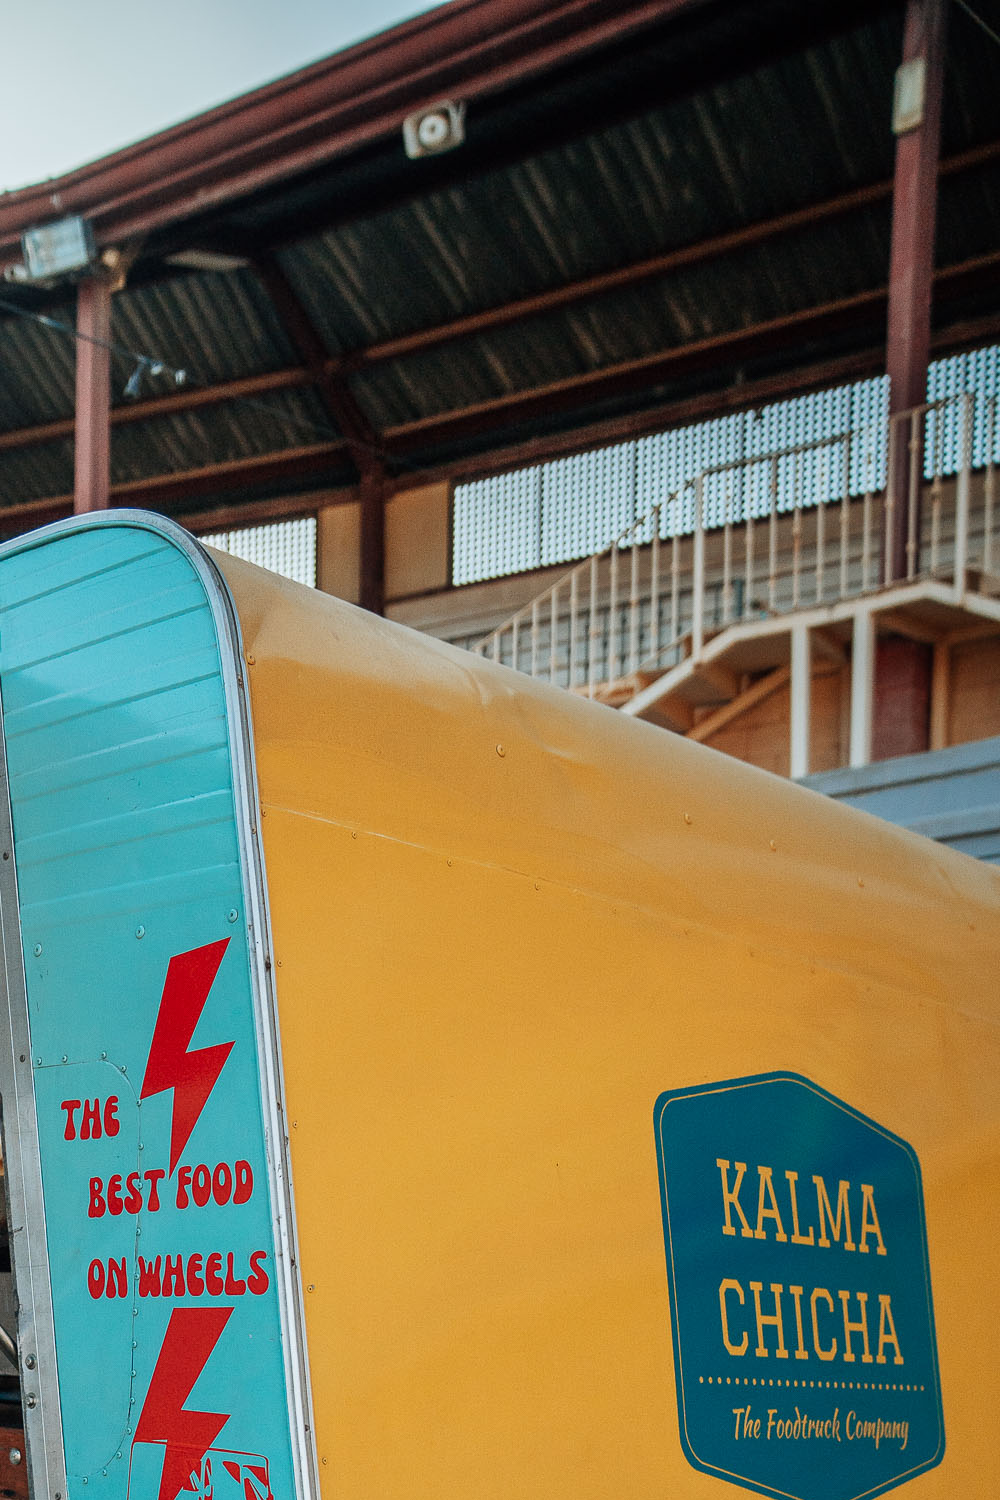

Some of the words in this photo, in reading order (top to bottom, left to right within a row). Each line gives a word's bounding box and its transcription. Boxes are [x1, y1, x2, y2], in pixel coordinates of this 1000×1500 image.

[61, 1095, 120, 1141] THE
[88, 1169, 165, 1218] BEST
[175, 1160, 254, 1210] FOOD
[716, 1157, 887, 1256] KALMA
[88, 1257, 128, 1300] ON
[138, 1250, 269, 1298] WHEELS
[719, 1278, 904, 1365] CHICHA
[732, 1405, 761, 1440] The
[767, 1406, 841, 1442] Foodtruck
[845, 1410, 909, 1450] Company
